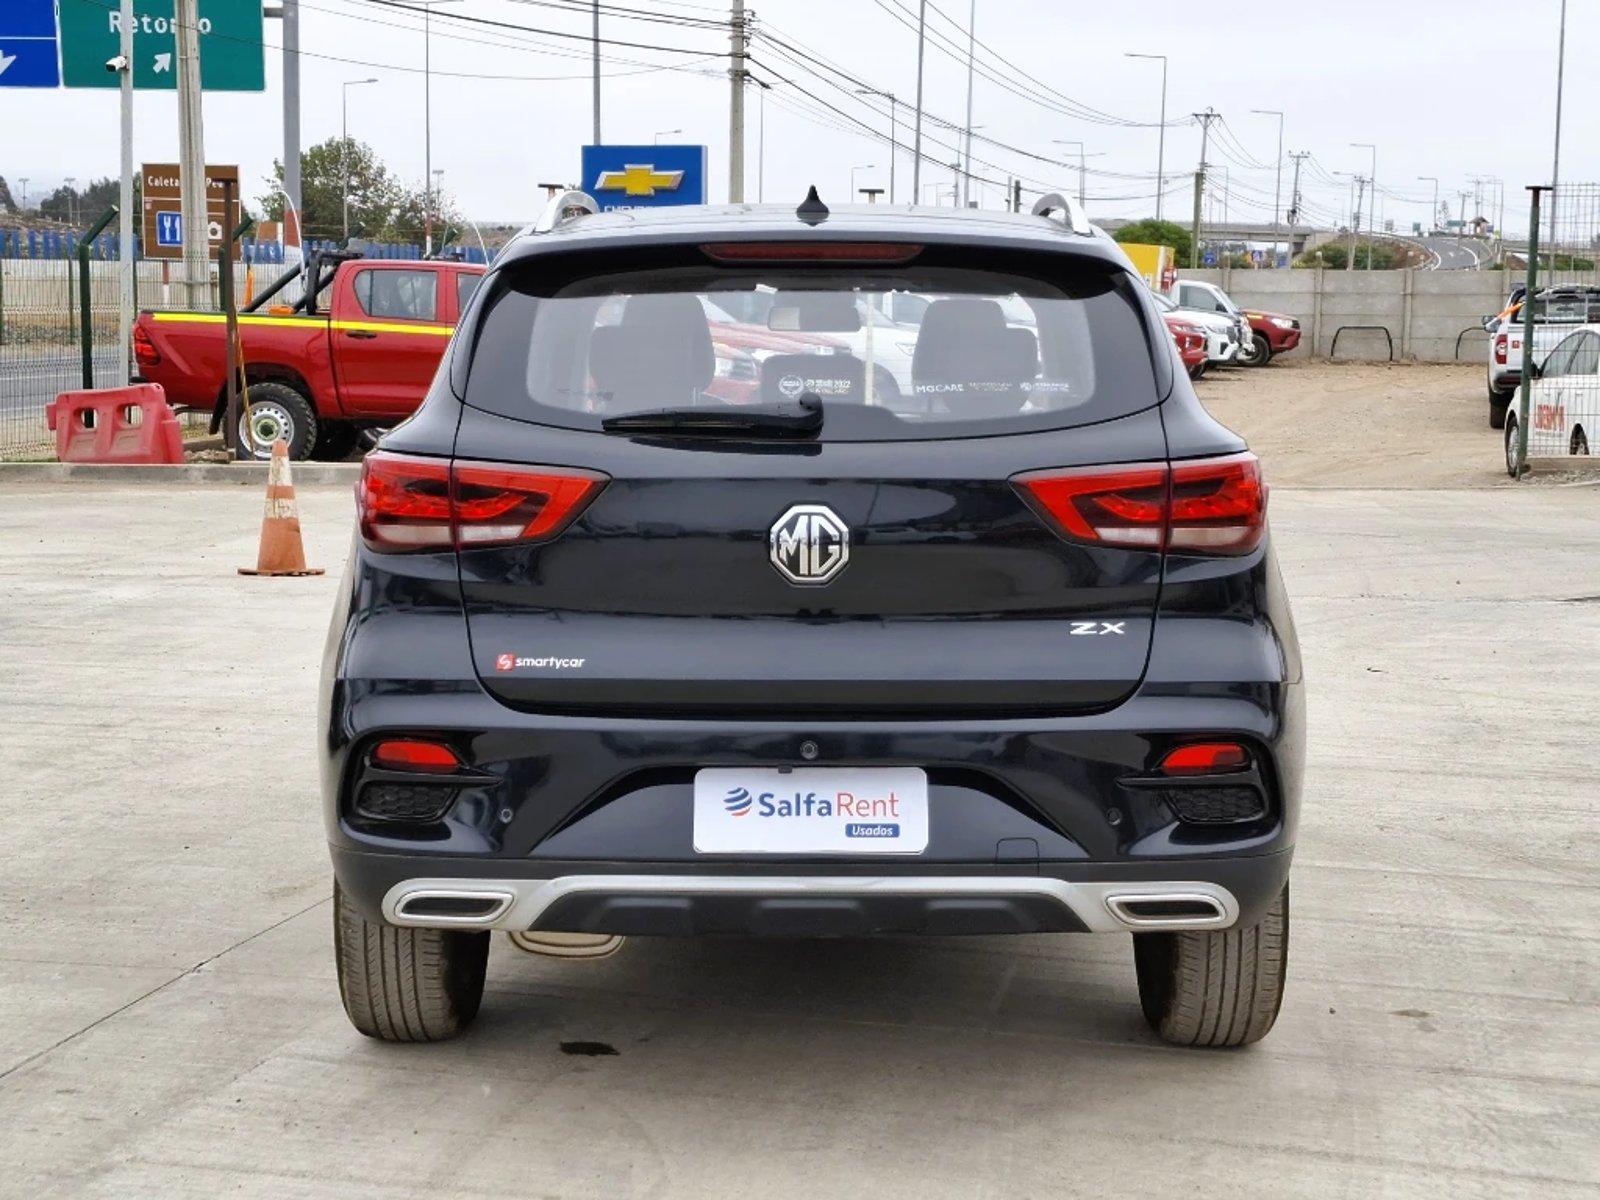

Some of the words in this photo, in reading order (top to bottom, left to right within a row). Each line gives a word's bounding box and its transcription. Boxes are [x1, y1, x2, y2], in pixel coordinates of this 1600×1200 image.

[778, 514, 840, 576] MG
[1069, 621, 1126, 636] ZX
[515, 656, 585, 669] smartycar
[758, 791, 900, 818] SalfaRent
[851, 825, 894, 836] Usados
